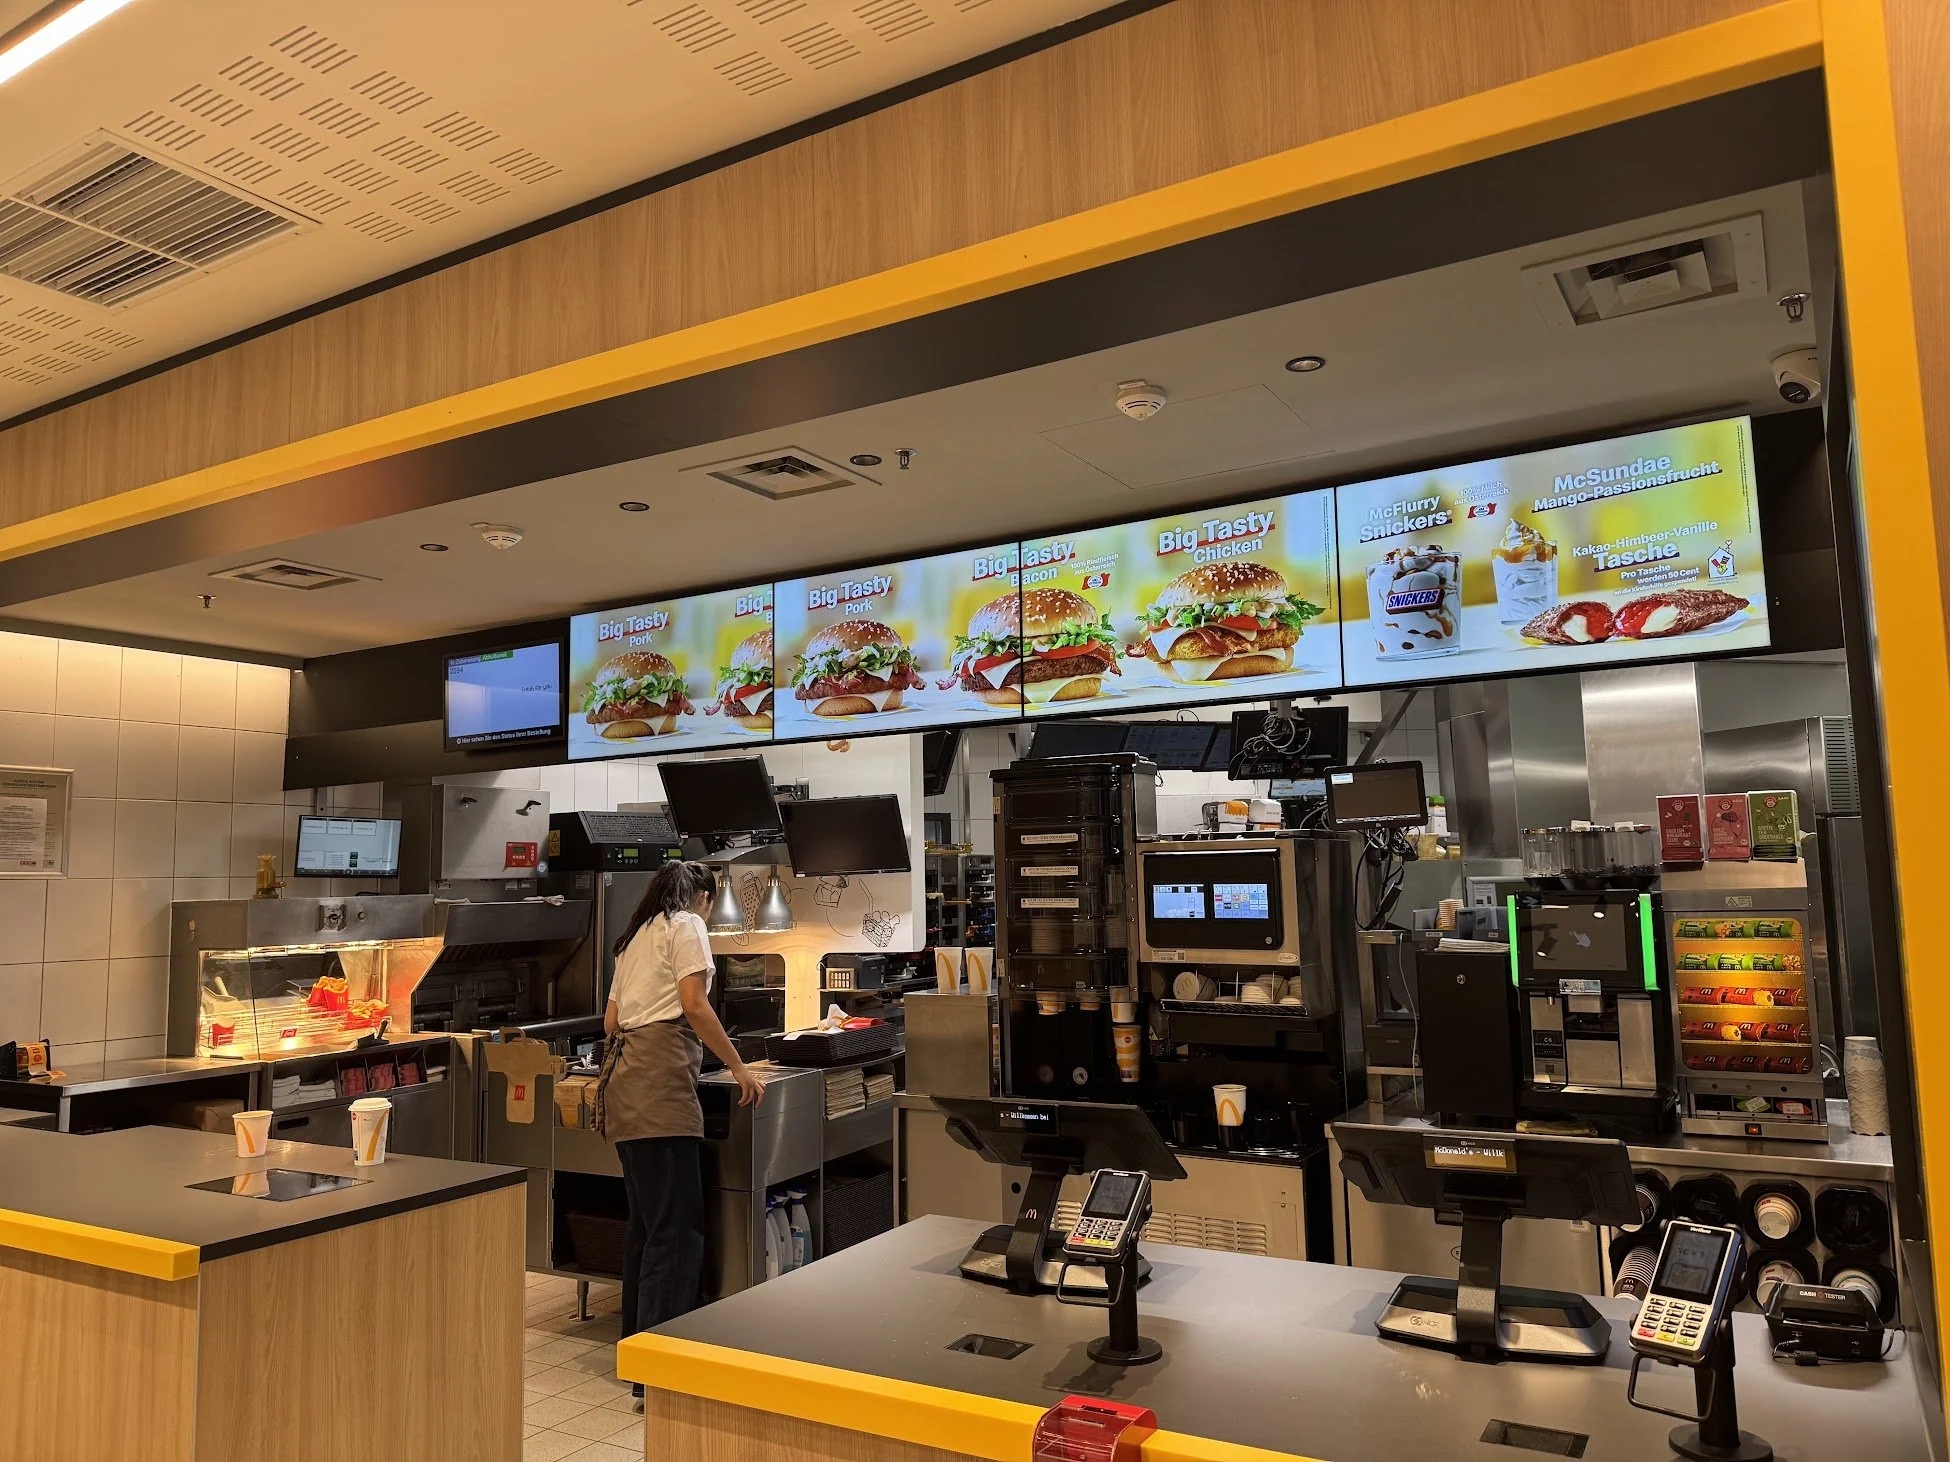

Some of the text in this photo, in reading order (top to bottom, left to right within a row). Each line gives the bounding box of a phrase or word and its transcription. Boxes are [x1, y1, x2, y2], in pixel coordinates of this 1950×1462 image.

[1554, 456, 1671, 493] McSundae
[1481, 481, 1502, 491] Milch
[1534, 461, 1719, 512] Mango-Passionsfrucht
[1369, 495, 1440, 521] McFlurry
[1159, 512, 1273, 553] Big Tasty
[1572, 520, 1718, 557] Kakao-Himbeer-Vanille
[973, 540, 1075, 579] Big Tasty
[1071, 553, 1119, 569] 100% Rindfleisch
[1193, 538, 1263, 564] Chicken
[1593, 542, 1679, 570] Tasche
[1010, 566, 1057, 587] Bacon
[1085, 560, 1116, 572] Österreich
[1621, 564, 1671, 579] Pro Tasche
[1637, 574, 1667, 584] werden
[1679, 567, 1700, 577] Cent
[808, 575, 892, 609] Big Tasty
[1632, 582, 1664, 593] Kinderhilfe
[736, 594, 764, 616] Big
[845, 599, 872, 616] Pork
[1388, 590, 1438, 608] SNICKERS
[599, 611, 670, 642] Big Tasty
[629, 633, 653, 648] Pork
[1434, 1146, 1474, 1155] McDonald's
